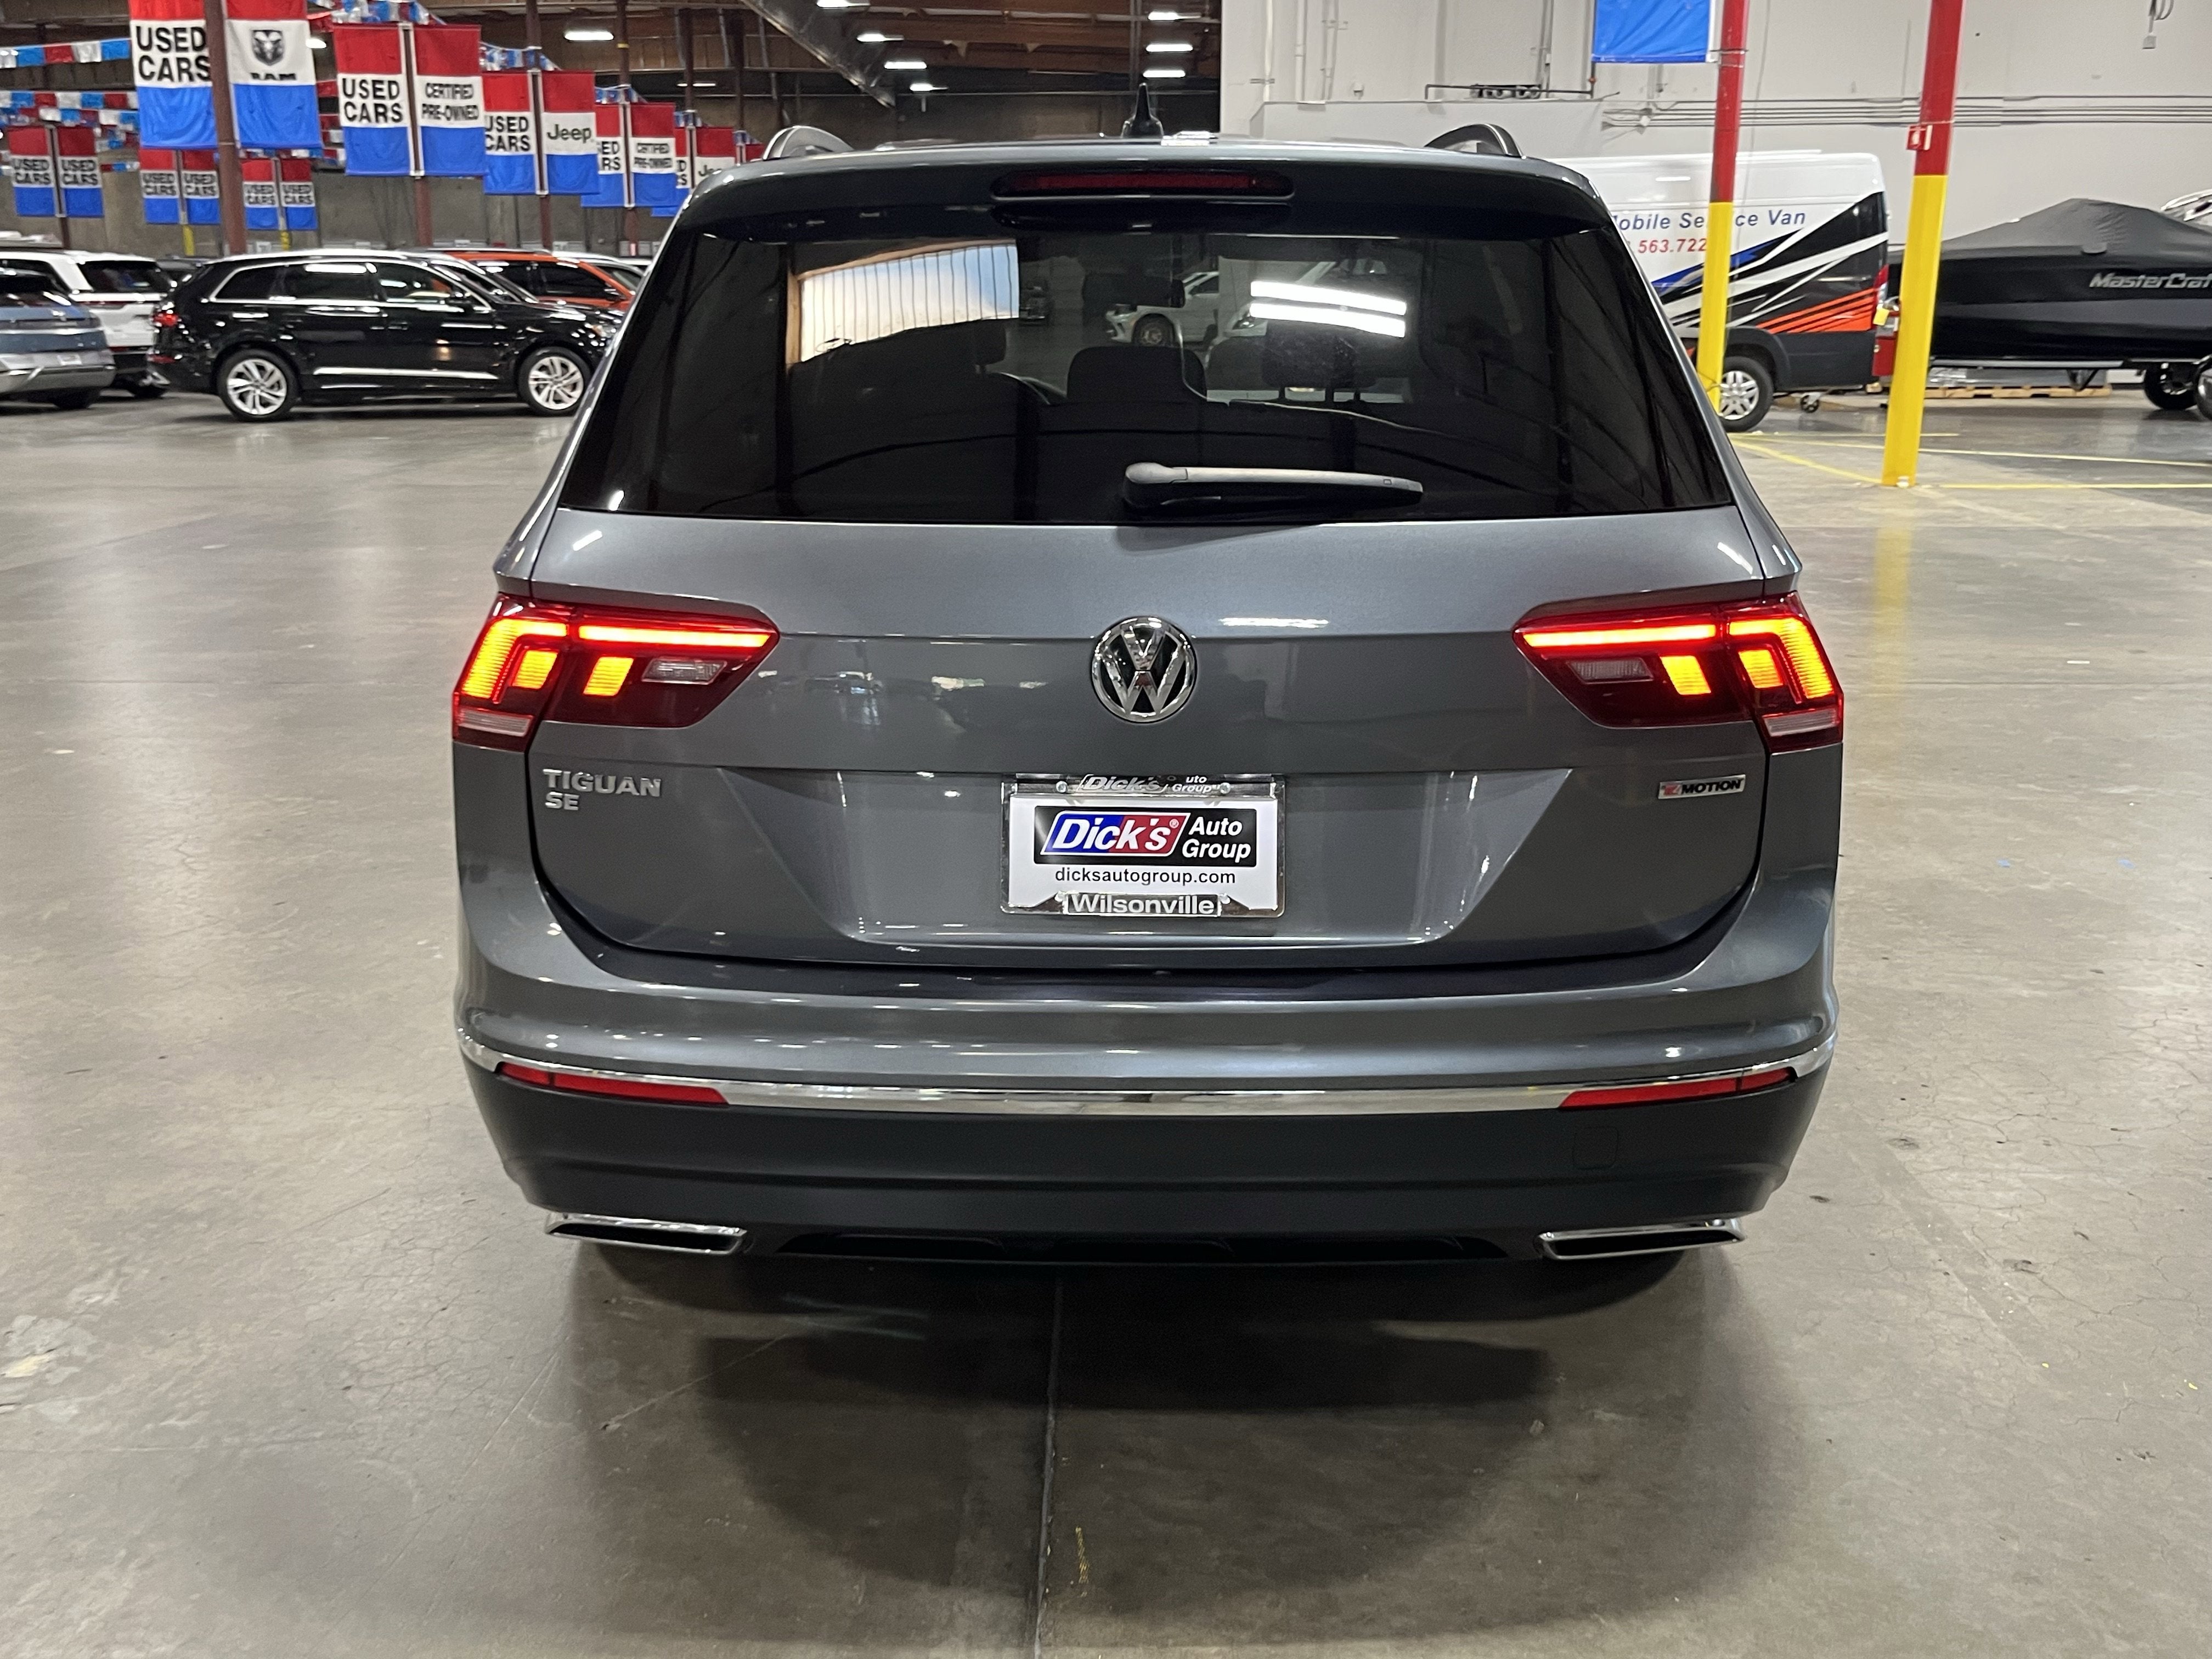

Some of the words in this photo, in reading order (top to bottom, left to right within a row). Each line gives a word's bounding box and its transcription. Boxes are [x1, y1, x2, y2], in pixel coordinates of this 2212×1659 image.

[136, 26, 206, 53] USED
[138, 55, 211, 82] CARS
[342, 78, 400, 100] USED
[425, 83, 474, 99] CERTIFIED
[344, 101, 403, 123] CARS
[422, 103, 479, 121] PRE-OWNED
[486, 116, 529, 133] USED
[547, 124, 592, 144] Jeep
[486, 134, 531, 151] CARS
[598, 141, 620, 154] ED
[601, 156, 621, 170] RS
[1613, 214, 1671, 230] obile
[1679, 212, 1758, 229] Sece
[1768, 209, 1806, 225] Van
[2089, 273, 2212, 289] MasterCraf
[543, 769, 661, 797] TIGUAN
[1082, 776, 1161, 791] Dick's
[1172, 783, 1212, 794] Group
[1186, 775, 1207, 783] uto
[545, 791, 579, 811] SE
[1052, 817, 1172, 851] Dick's
[1188, 816, 1243, 837] Auto
[1182, 838, 1251, 863] Group
[1055, 867, 1236, 886] dicksautogroup.com
[1071, 893, 1215, 915] Wilsonville
